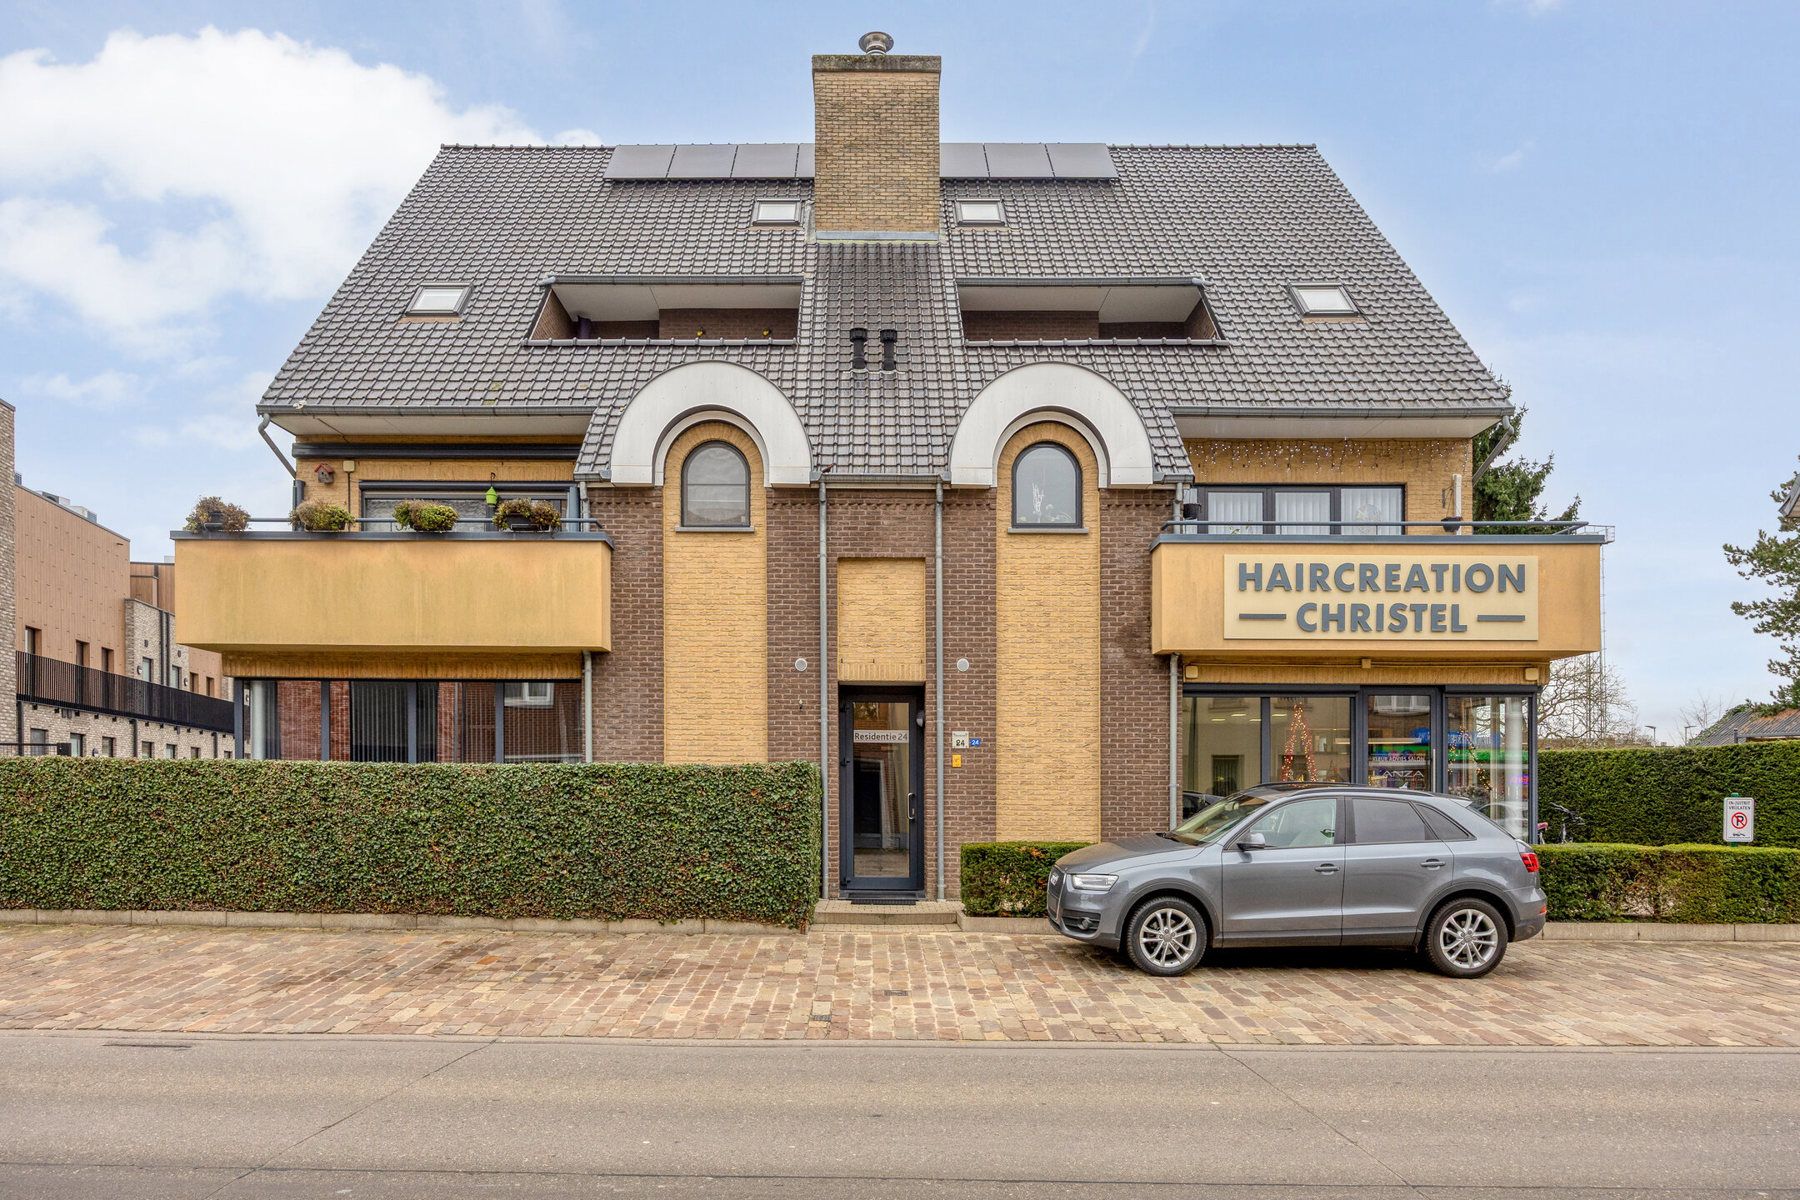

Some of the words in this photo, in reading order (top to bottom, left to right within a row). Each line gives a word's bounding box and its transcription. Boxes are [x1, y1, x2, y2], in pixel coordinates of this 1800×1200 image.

[1238, 562, 1525, 593] HAIRCREATION
[1296, 602, 1467, 632] CHRISTEL
[854, 732, 897, 741] Residentie
[898, 733, 908, 741] 24
